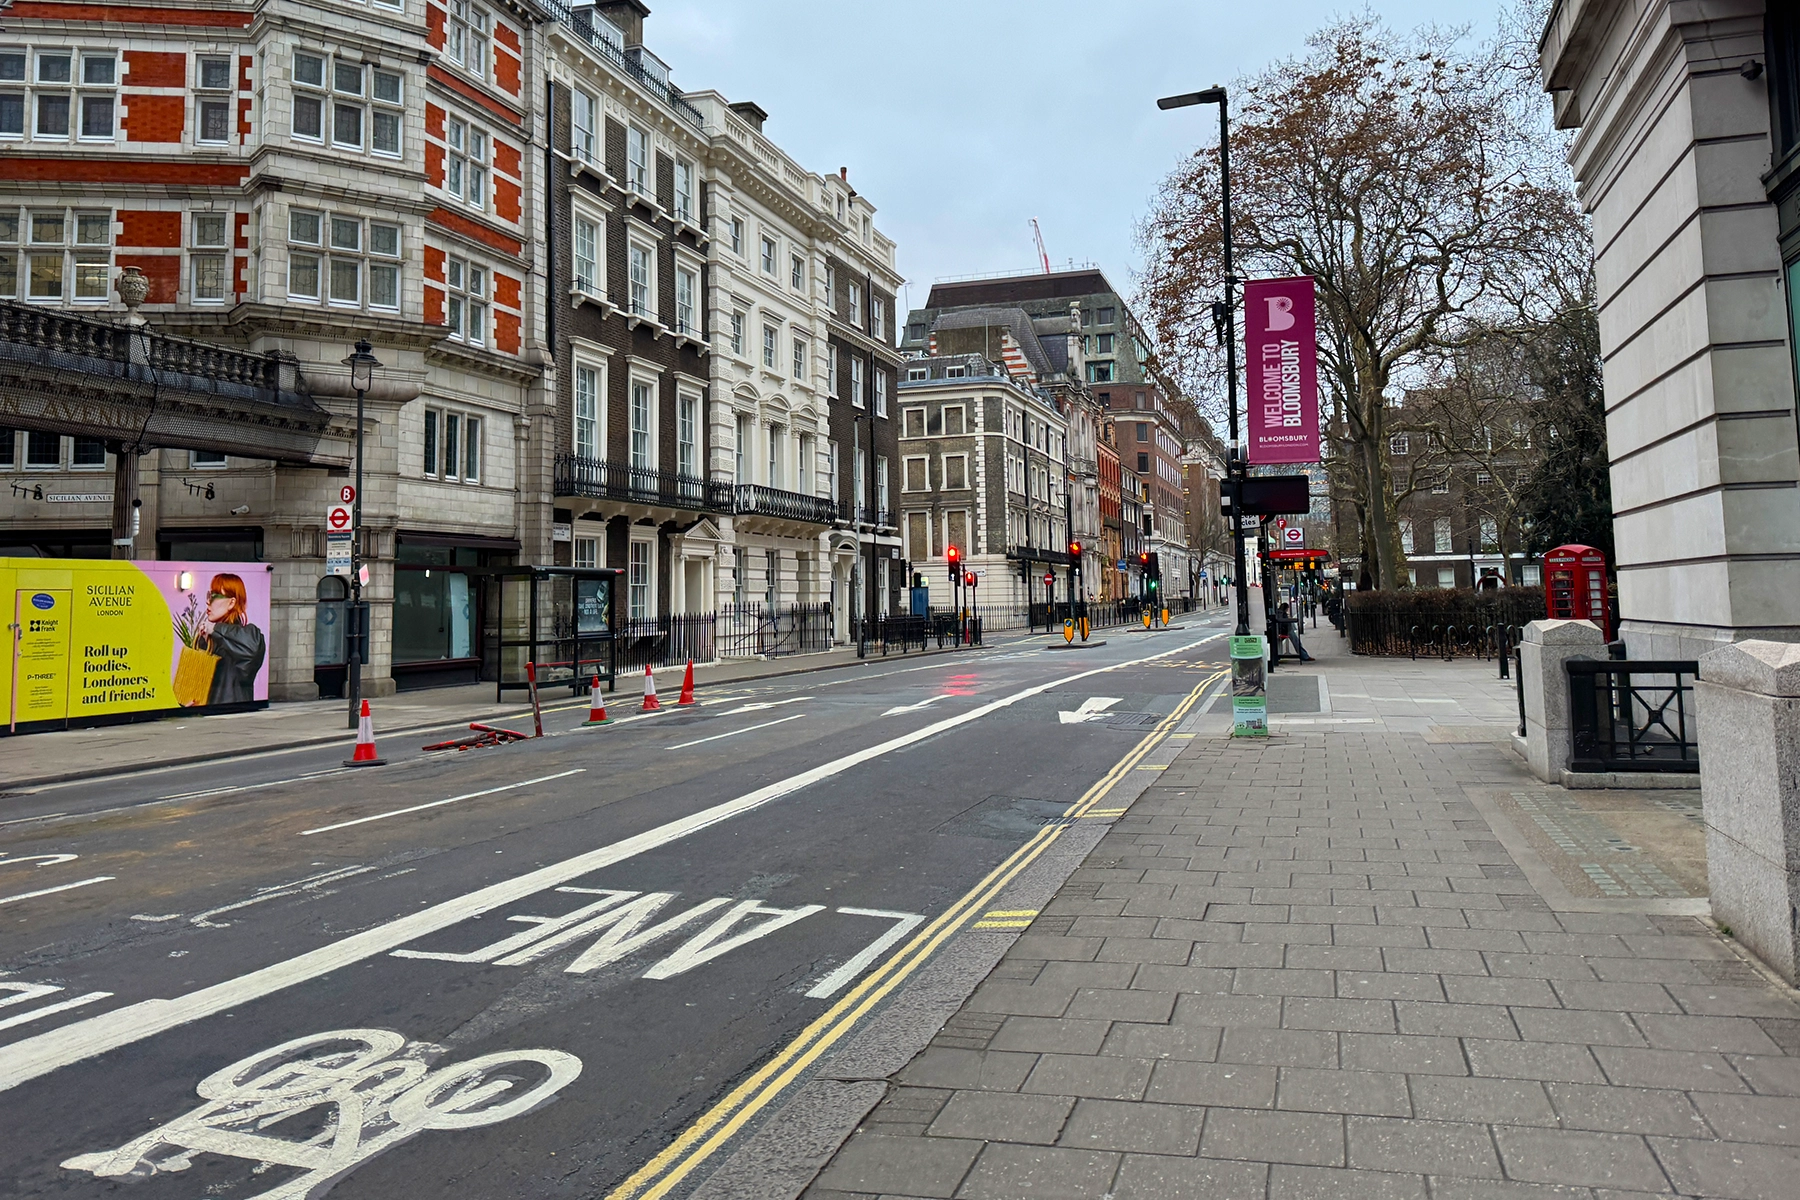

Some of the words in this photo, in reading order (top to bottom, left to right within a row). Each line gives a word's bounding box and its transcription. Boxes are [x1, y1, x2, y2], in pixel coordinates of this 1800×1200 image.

[1261, 343, 1281, 362] TO
[1280, 339, 1302, 427] BLOOMSBURY
[1262, 363, 1283, 429] WELCOME
[1258, 434, 1309, 443] BLOOMSBURY
[343, 488, 351, 500] B
[1279, 520, 1284, 528] F
[86, 585, 135, 595] SICILIAN
[89, 597, 132, 606] AVENUE
[84, 644, 109, 657] Roll
[112, 647, 128, 658] up
[83, 675, 149, 689] Londoners
[82, 691, 106, 704] and
[109, 688, 155, 702] friends!
